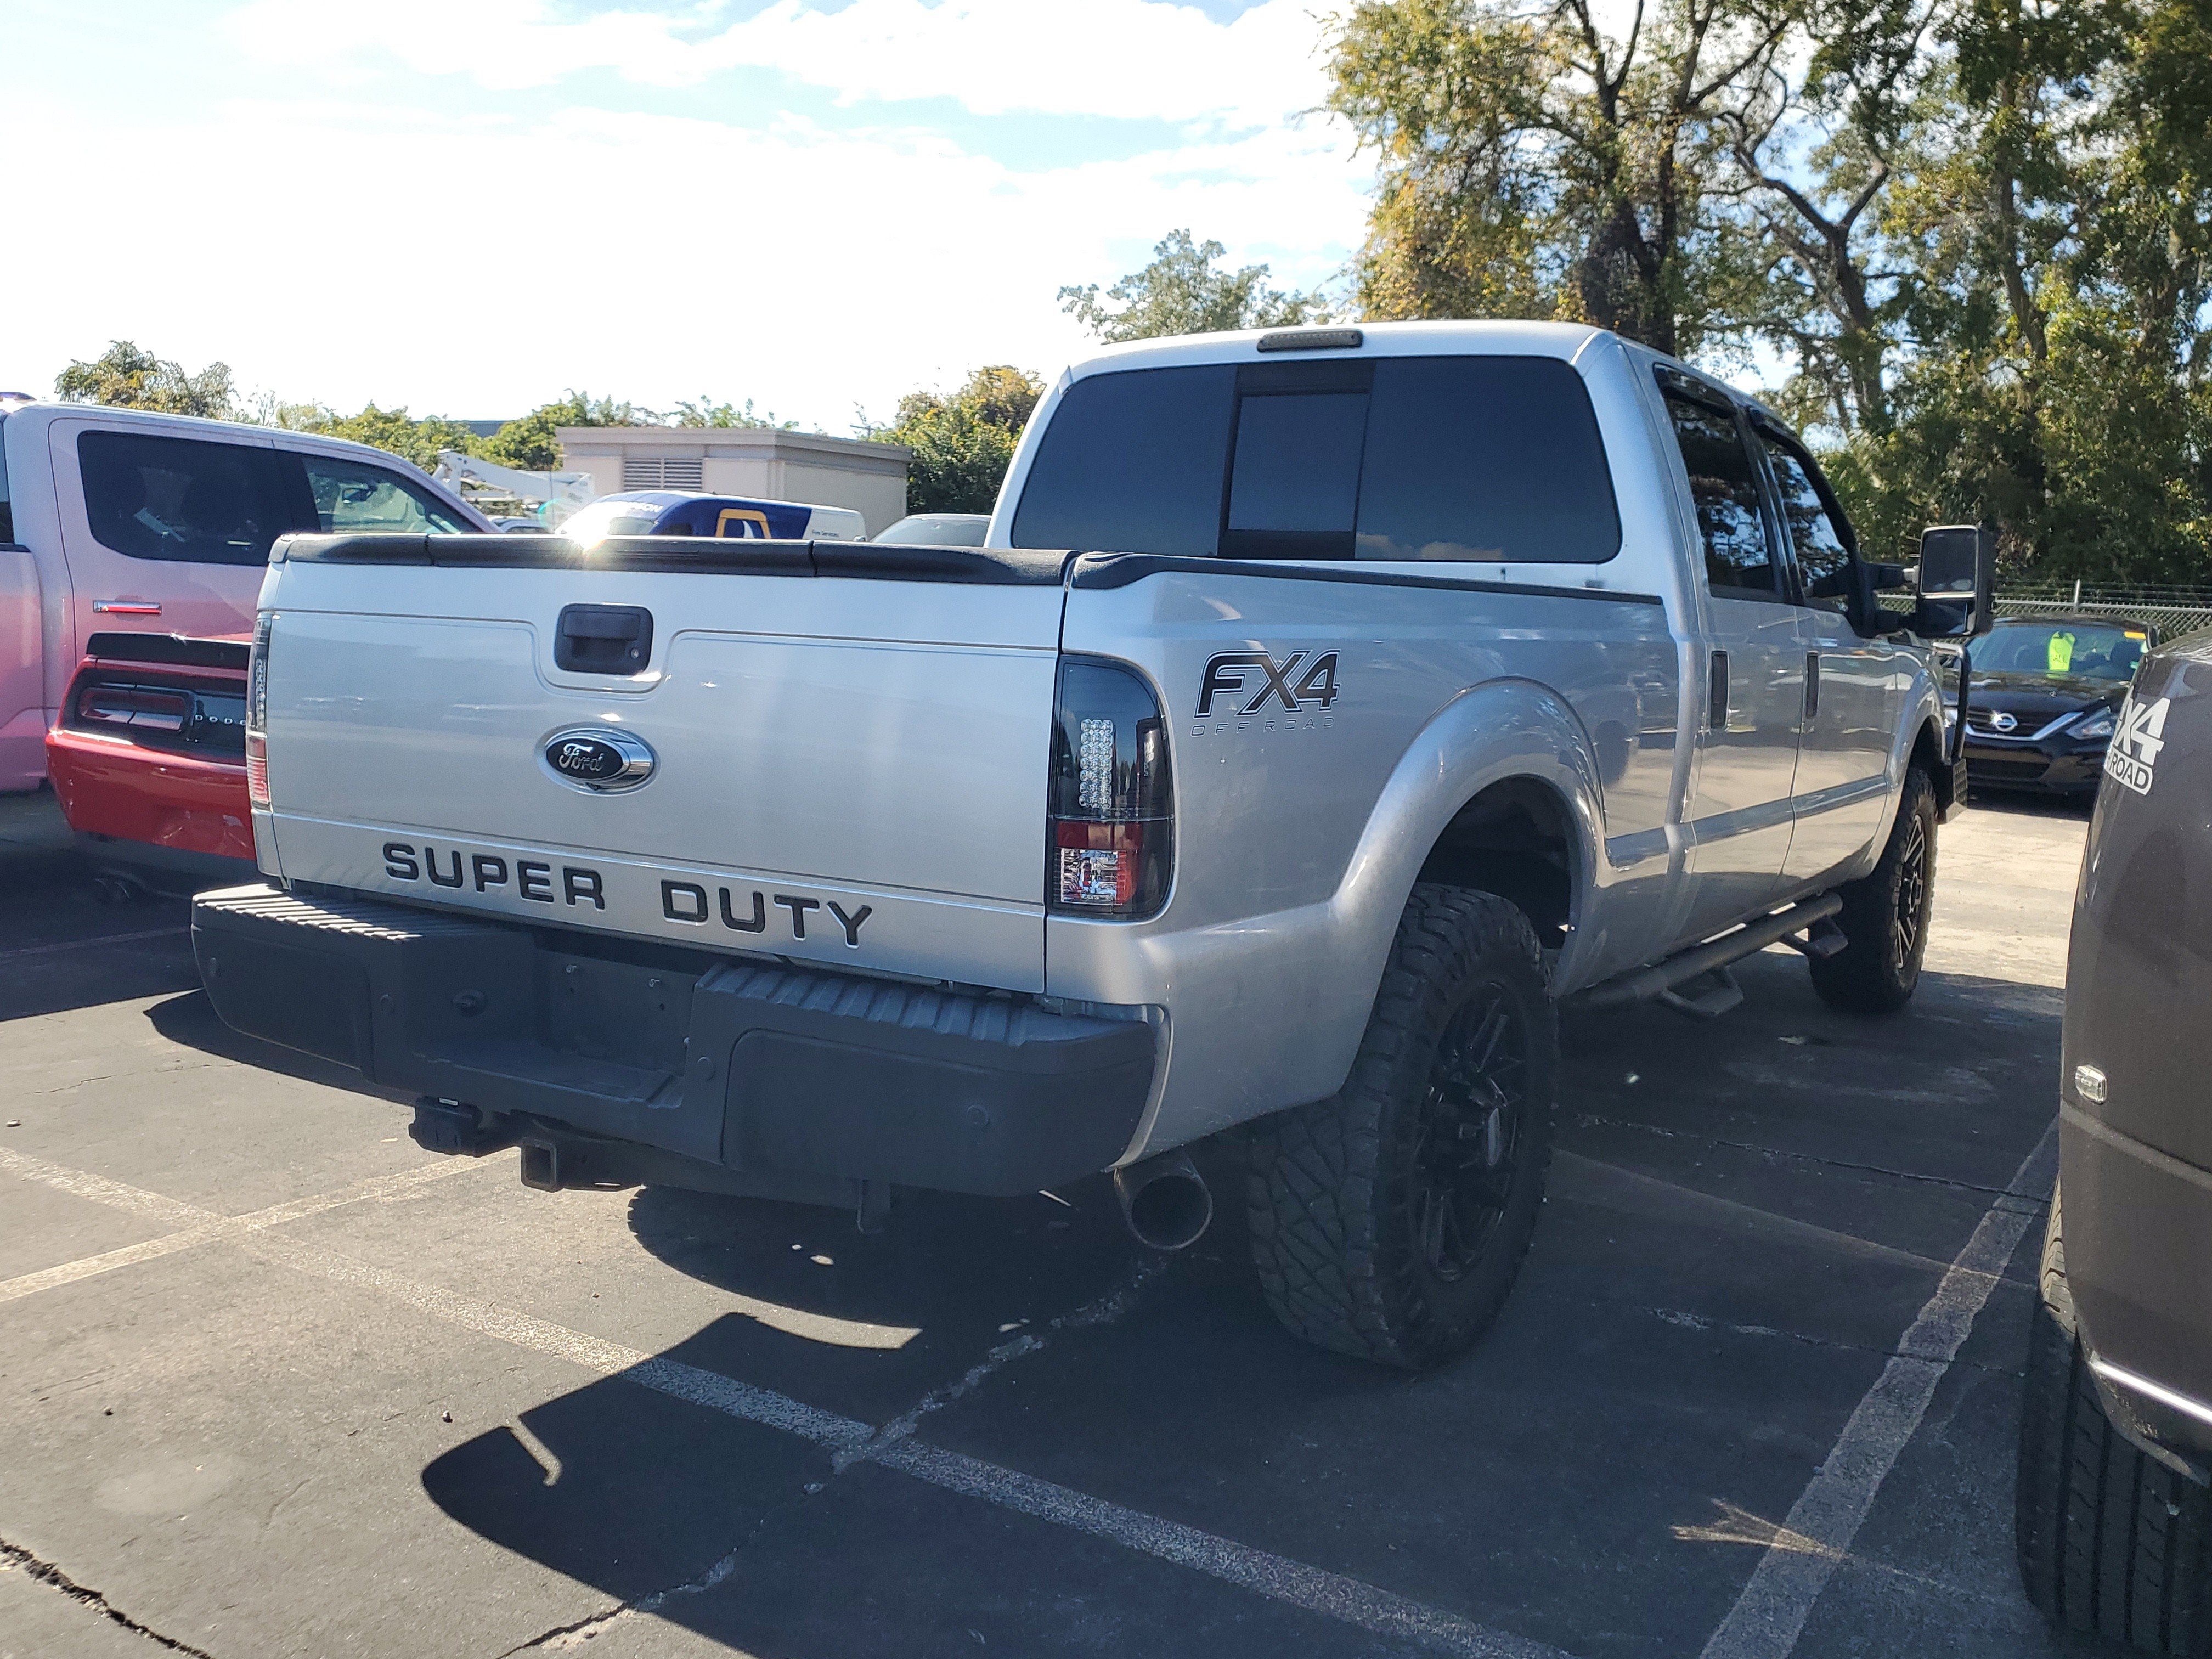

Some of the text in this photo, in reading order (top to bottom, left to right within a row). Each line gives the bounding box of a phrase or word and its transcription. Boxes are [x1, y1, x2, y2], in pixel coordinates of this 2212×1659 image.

[1193, 649, 1341, 719] FX4
[195, 714, 246, 725] DODG
[1190, 716, 1334, 737] OFF ROAD
[558, 743, 605, 772] Ford
[2109, 753, 2149, 789] ROAD
[383, 842, 873, 948] SUPER DUTY
